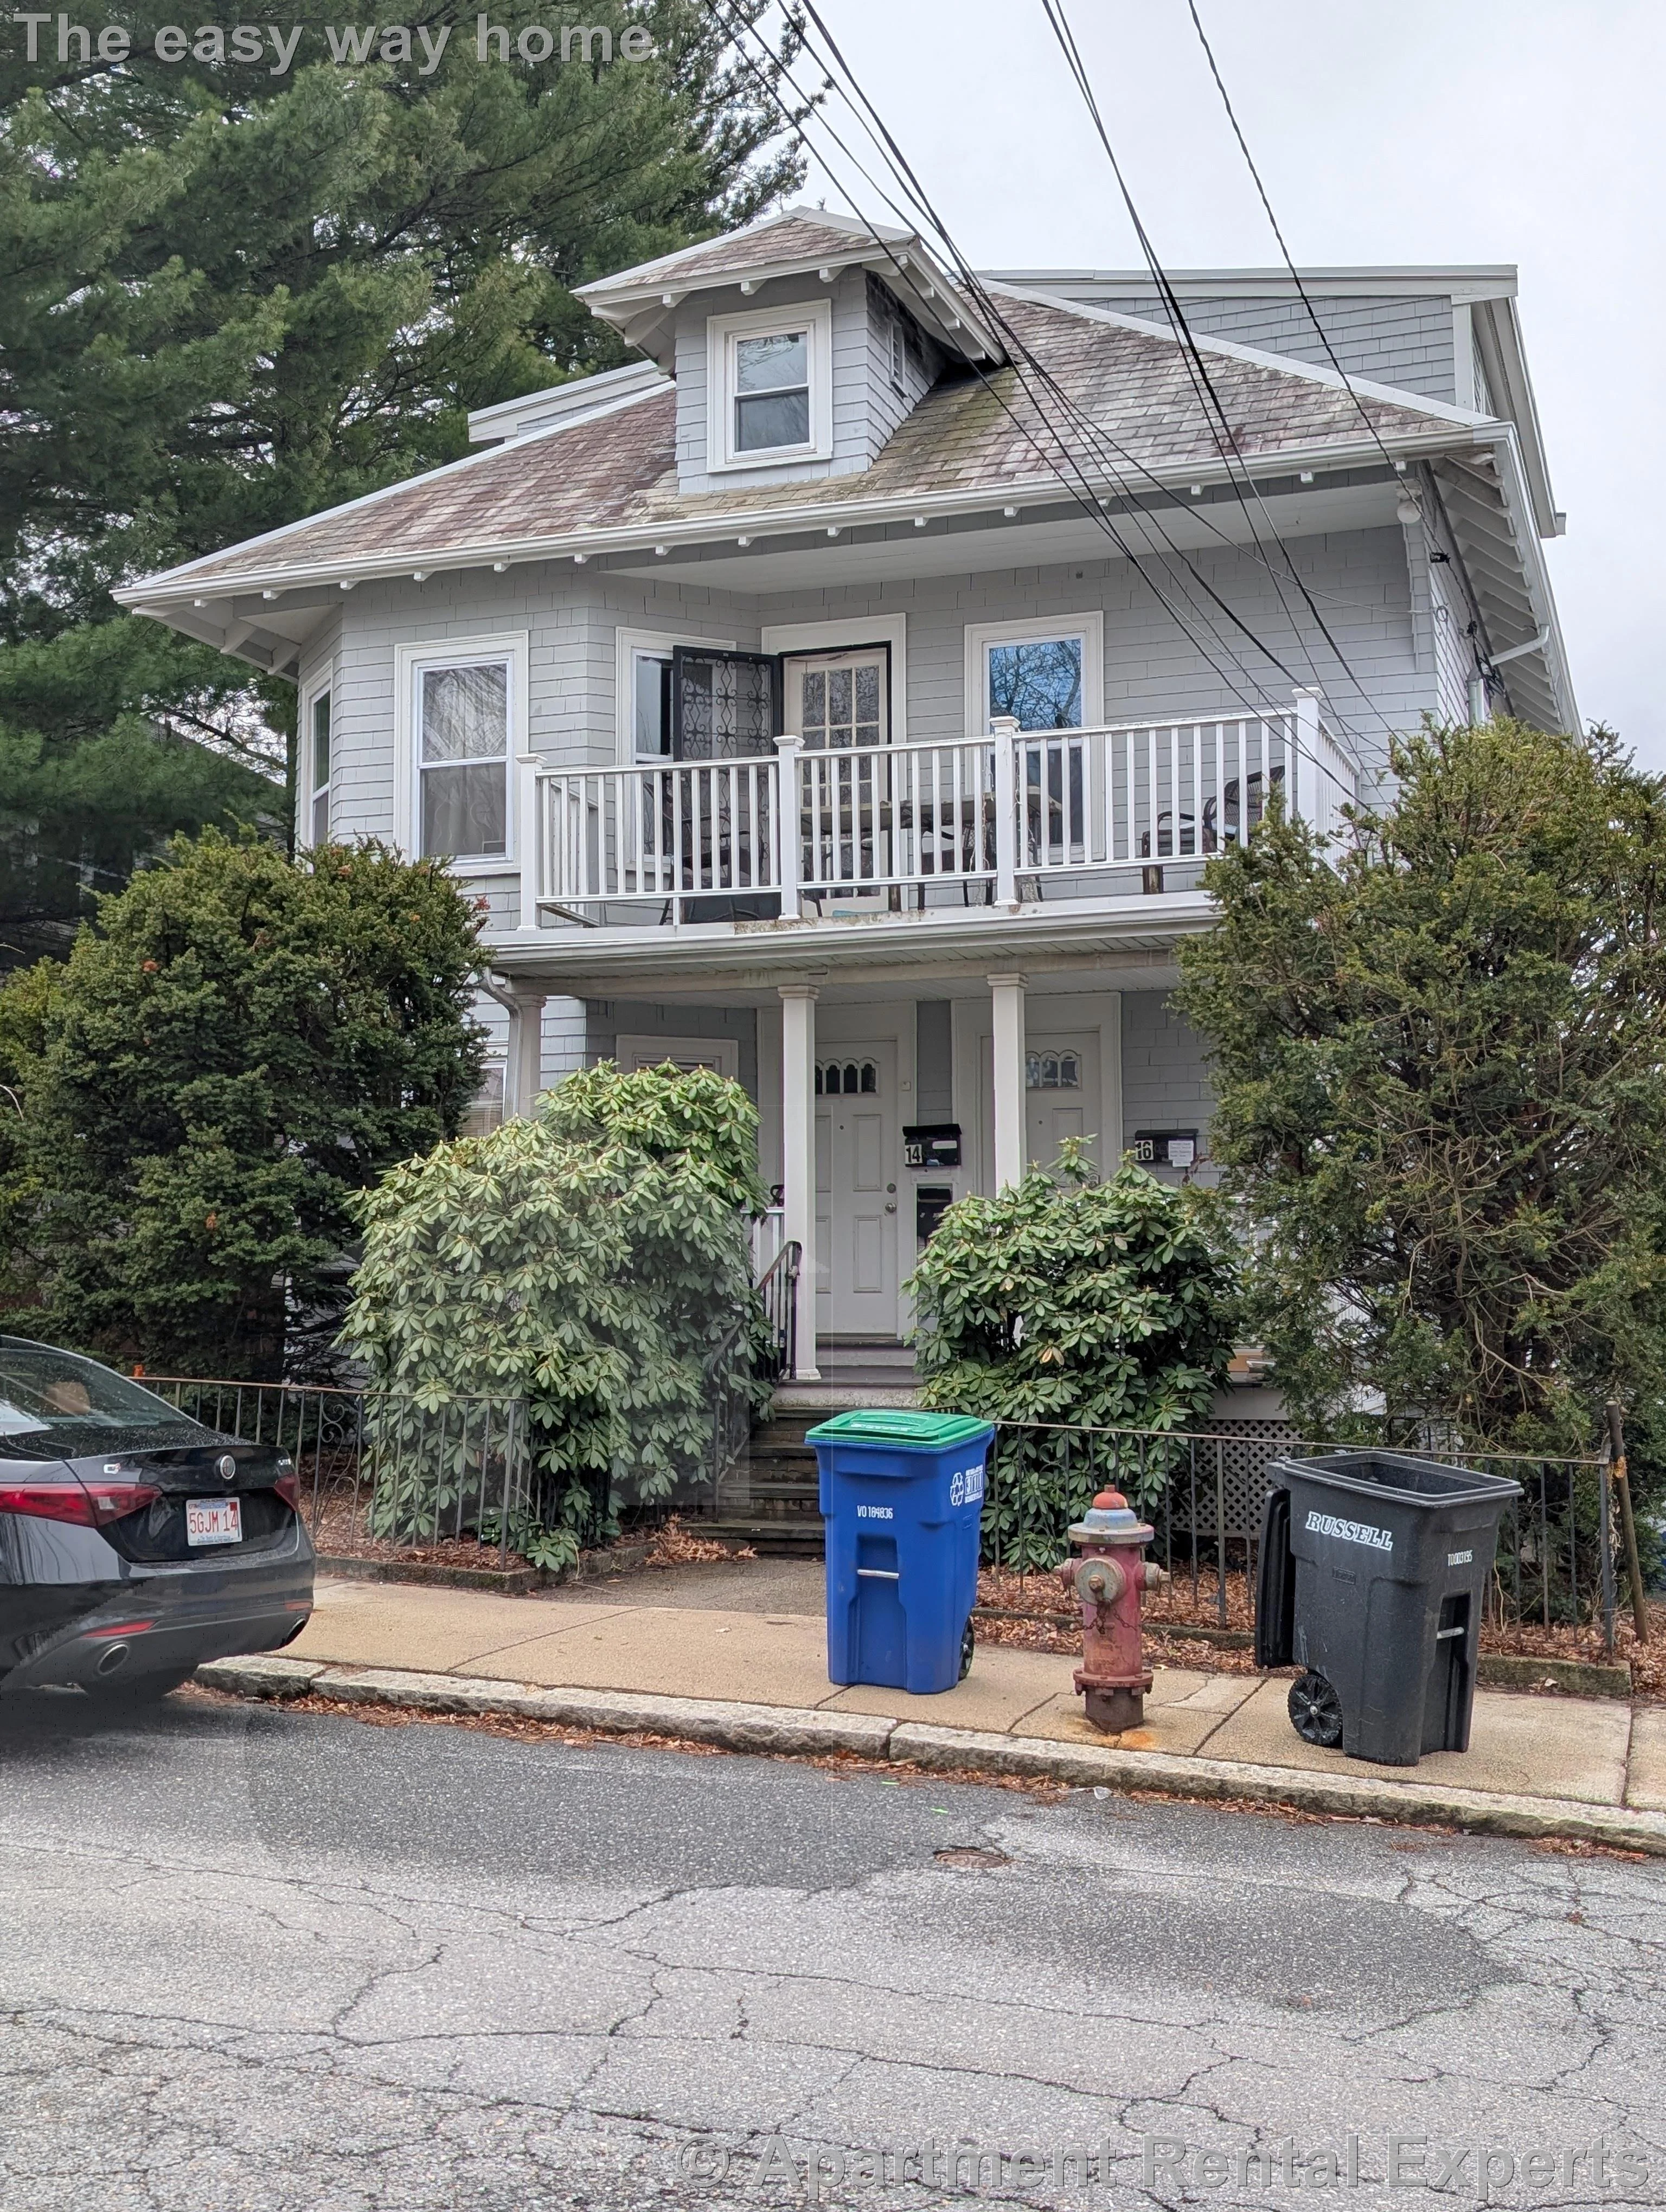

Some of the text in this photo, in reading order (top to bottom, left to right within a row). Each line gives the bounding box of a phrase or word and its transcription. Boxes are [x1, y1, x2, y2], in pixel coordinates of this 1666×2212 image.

[906, 1146, 921, 1163] 14
[189, 1510, 219, 1533] 5GJM
[1305, 1510, 1393, 1551] RUSSELL
